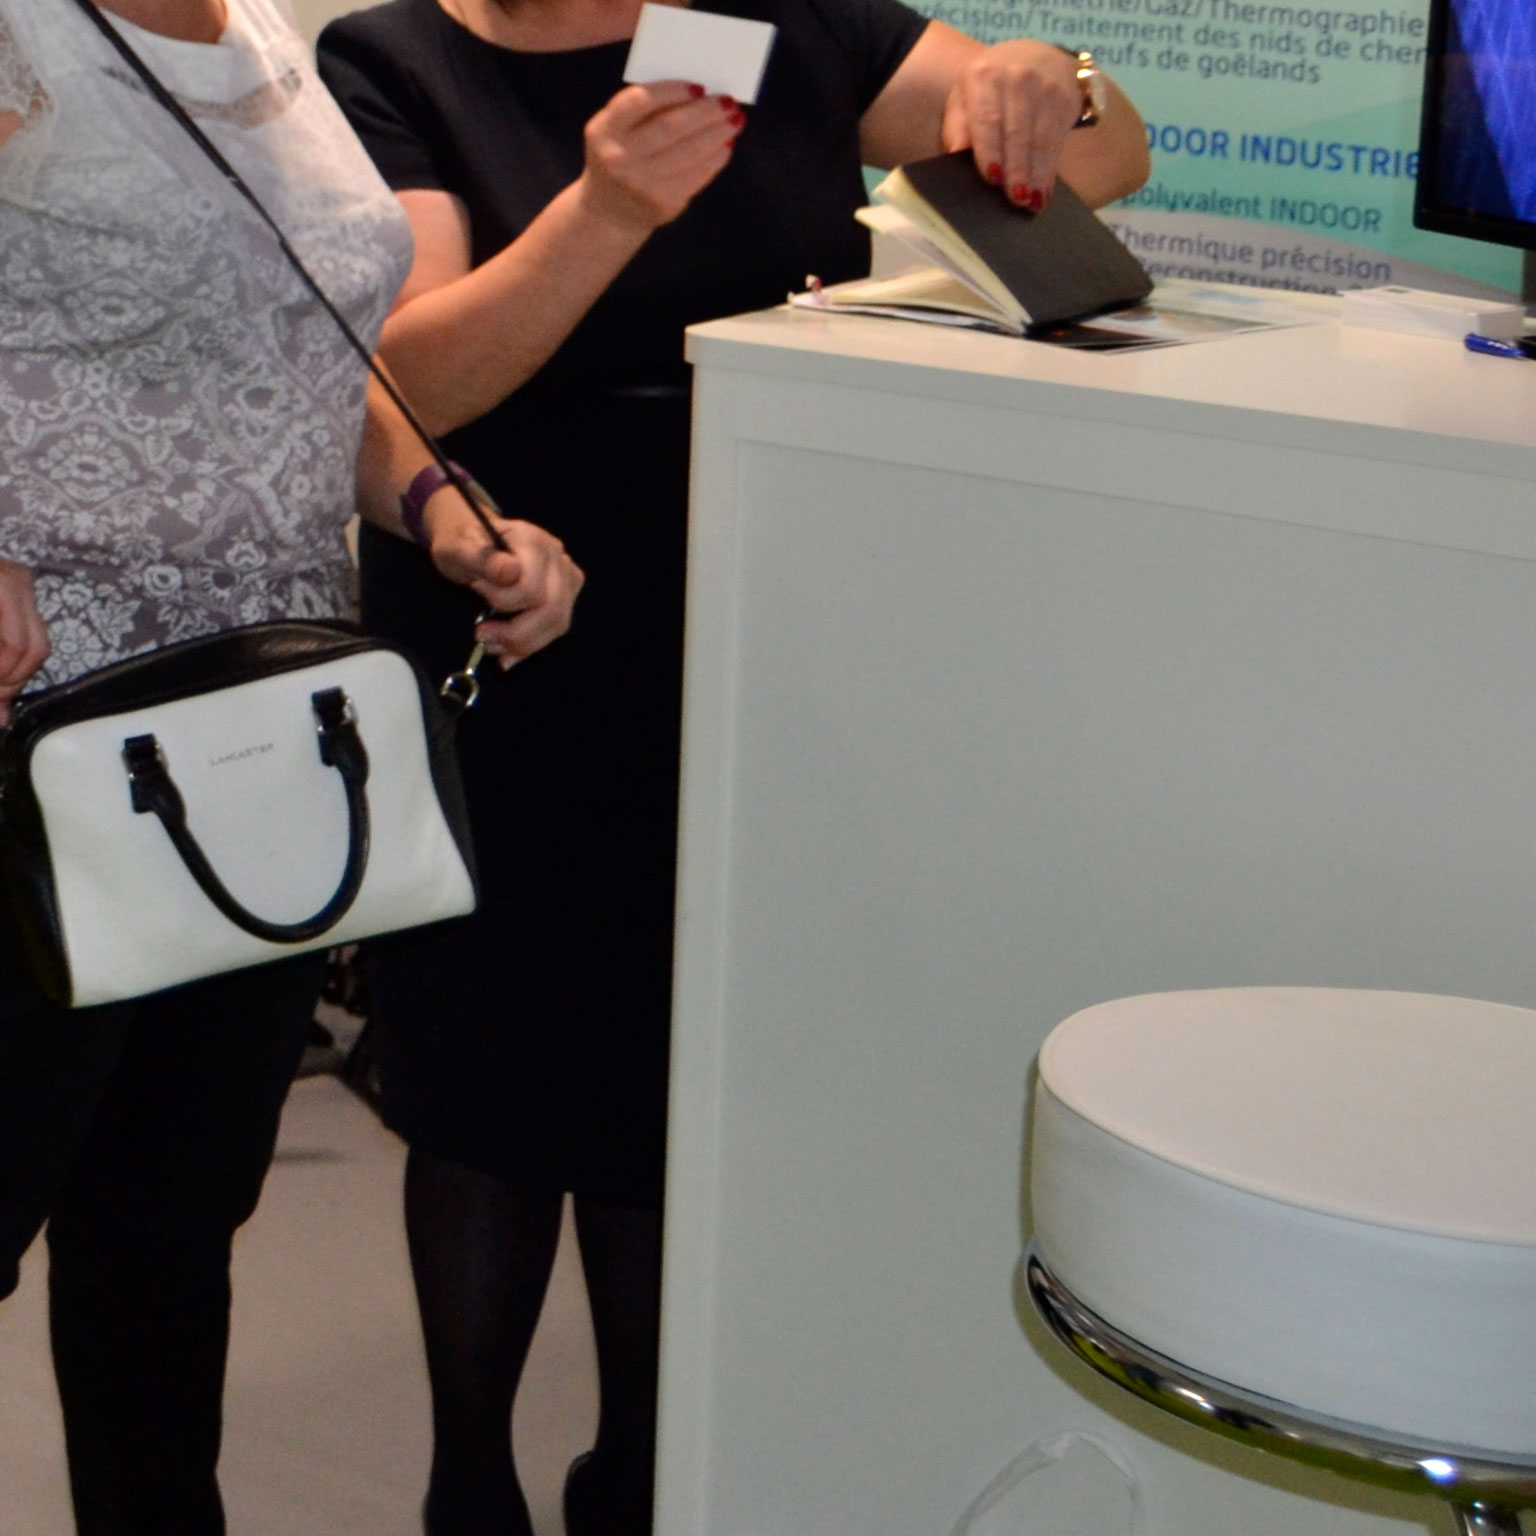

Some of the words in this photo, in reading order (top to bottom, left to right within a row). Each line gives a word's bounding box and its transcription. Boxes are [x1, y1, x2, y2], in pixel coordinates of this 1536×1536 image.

[1040, 10, 1184, 44] Traitement
[1193, 23, 1240, 48] des
[1250, 29, 1307, 56] nids
[1315, 32, 1350, 59] de
[1157, 46, 1191, 74] de
[1197, 47, 1321, 85] goëlands
[1270, 196, 1383, 233] INDOOR
[1261, 245, 1392, 283] précision
